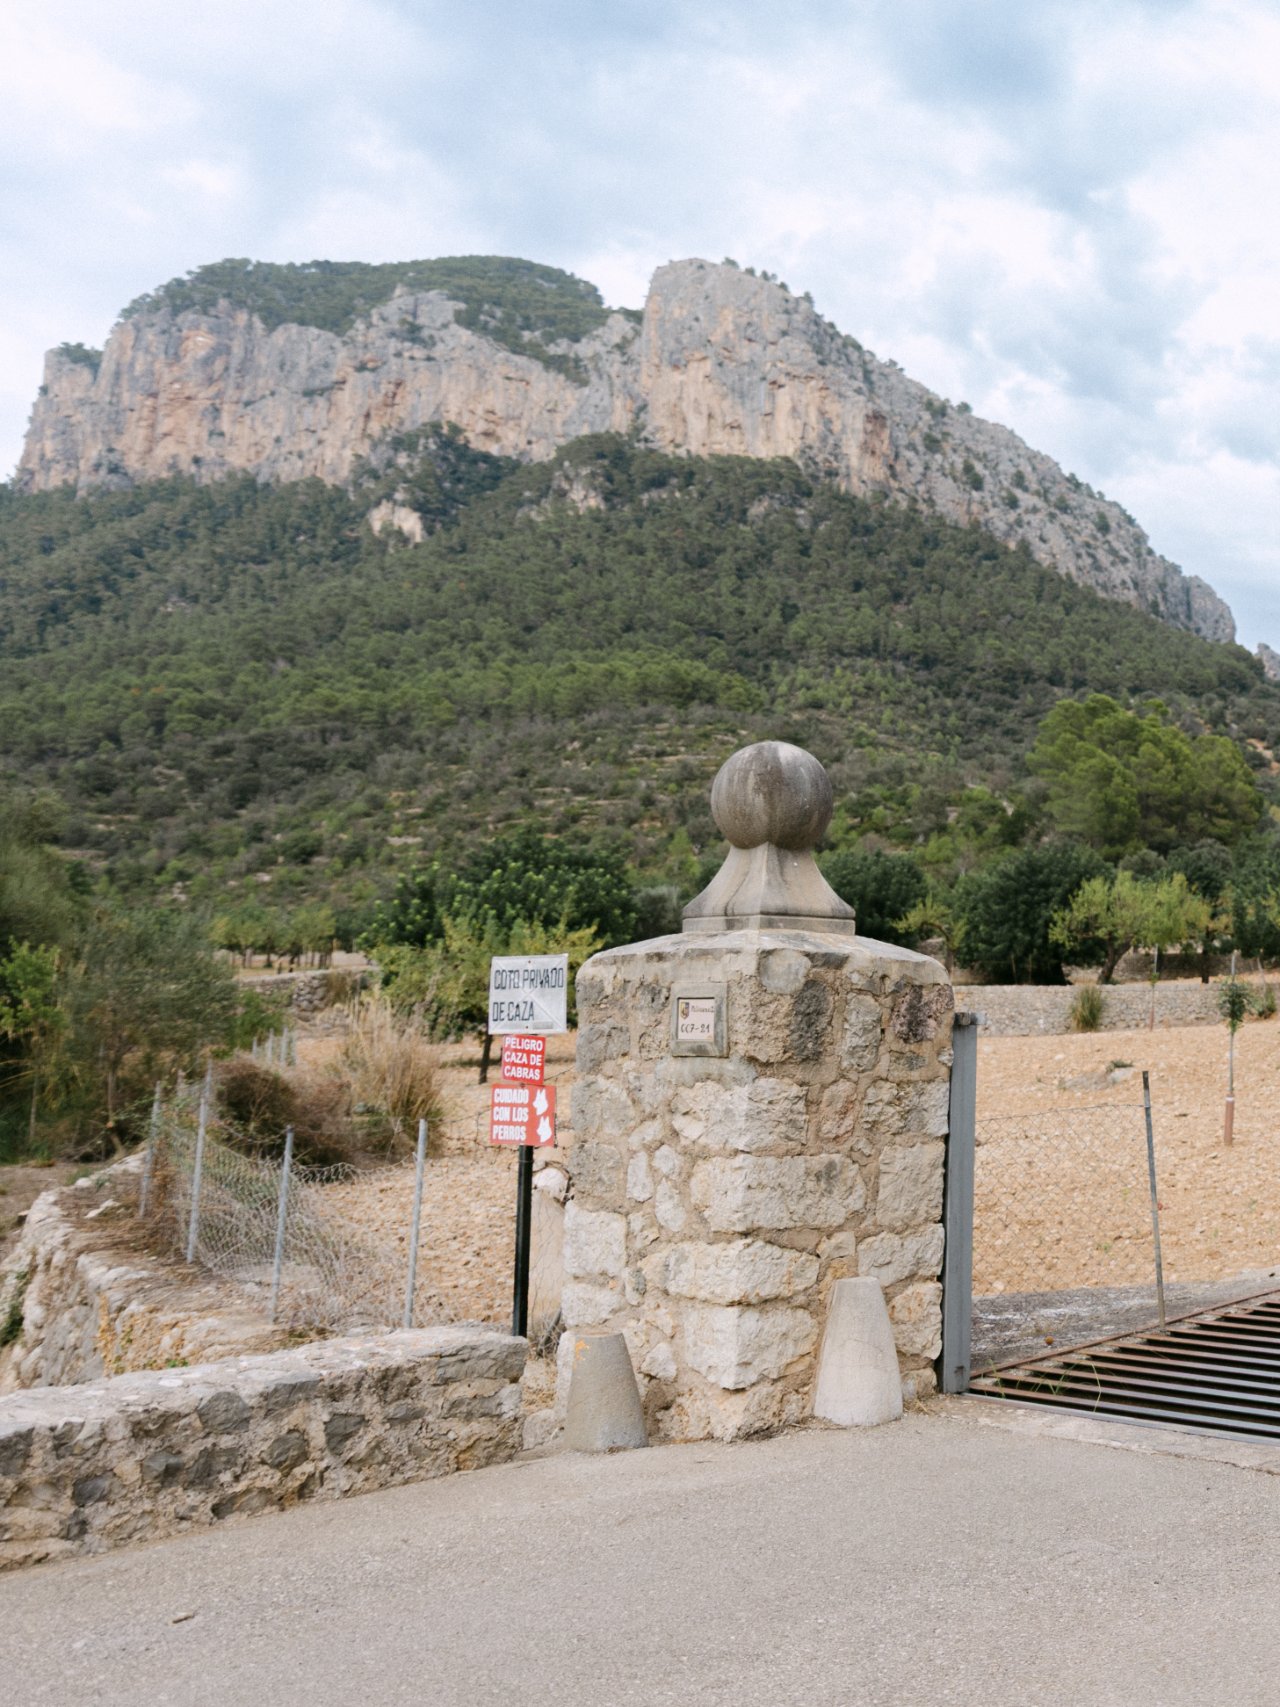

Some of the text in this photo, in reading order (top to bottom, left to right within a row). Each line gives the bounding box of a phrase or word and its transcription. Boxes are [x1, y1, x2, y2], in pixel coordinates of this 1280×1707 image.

[494, 967, 564, 990] COTO PRIVADO
[492, 1001, 535, 1022] DE CAZA
[504, 1036, 543, 1051] PELIGRO
[503, 1051, 542, 1066] CAZA DE
[503, 1065, 541, 1081] CABRAS
[493, 1088, 530, 1104] CUIDADO
[493, 1106, 529, 1122] CON LOS
[492, 1124, 527, 1141] PERROS
